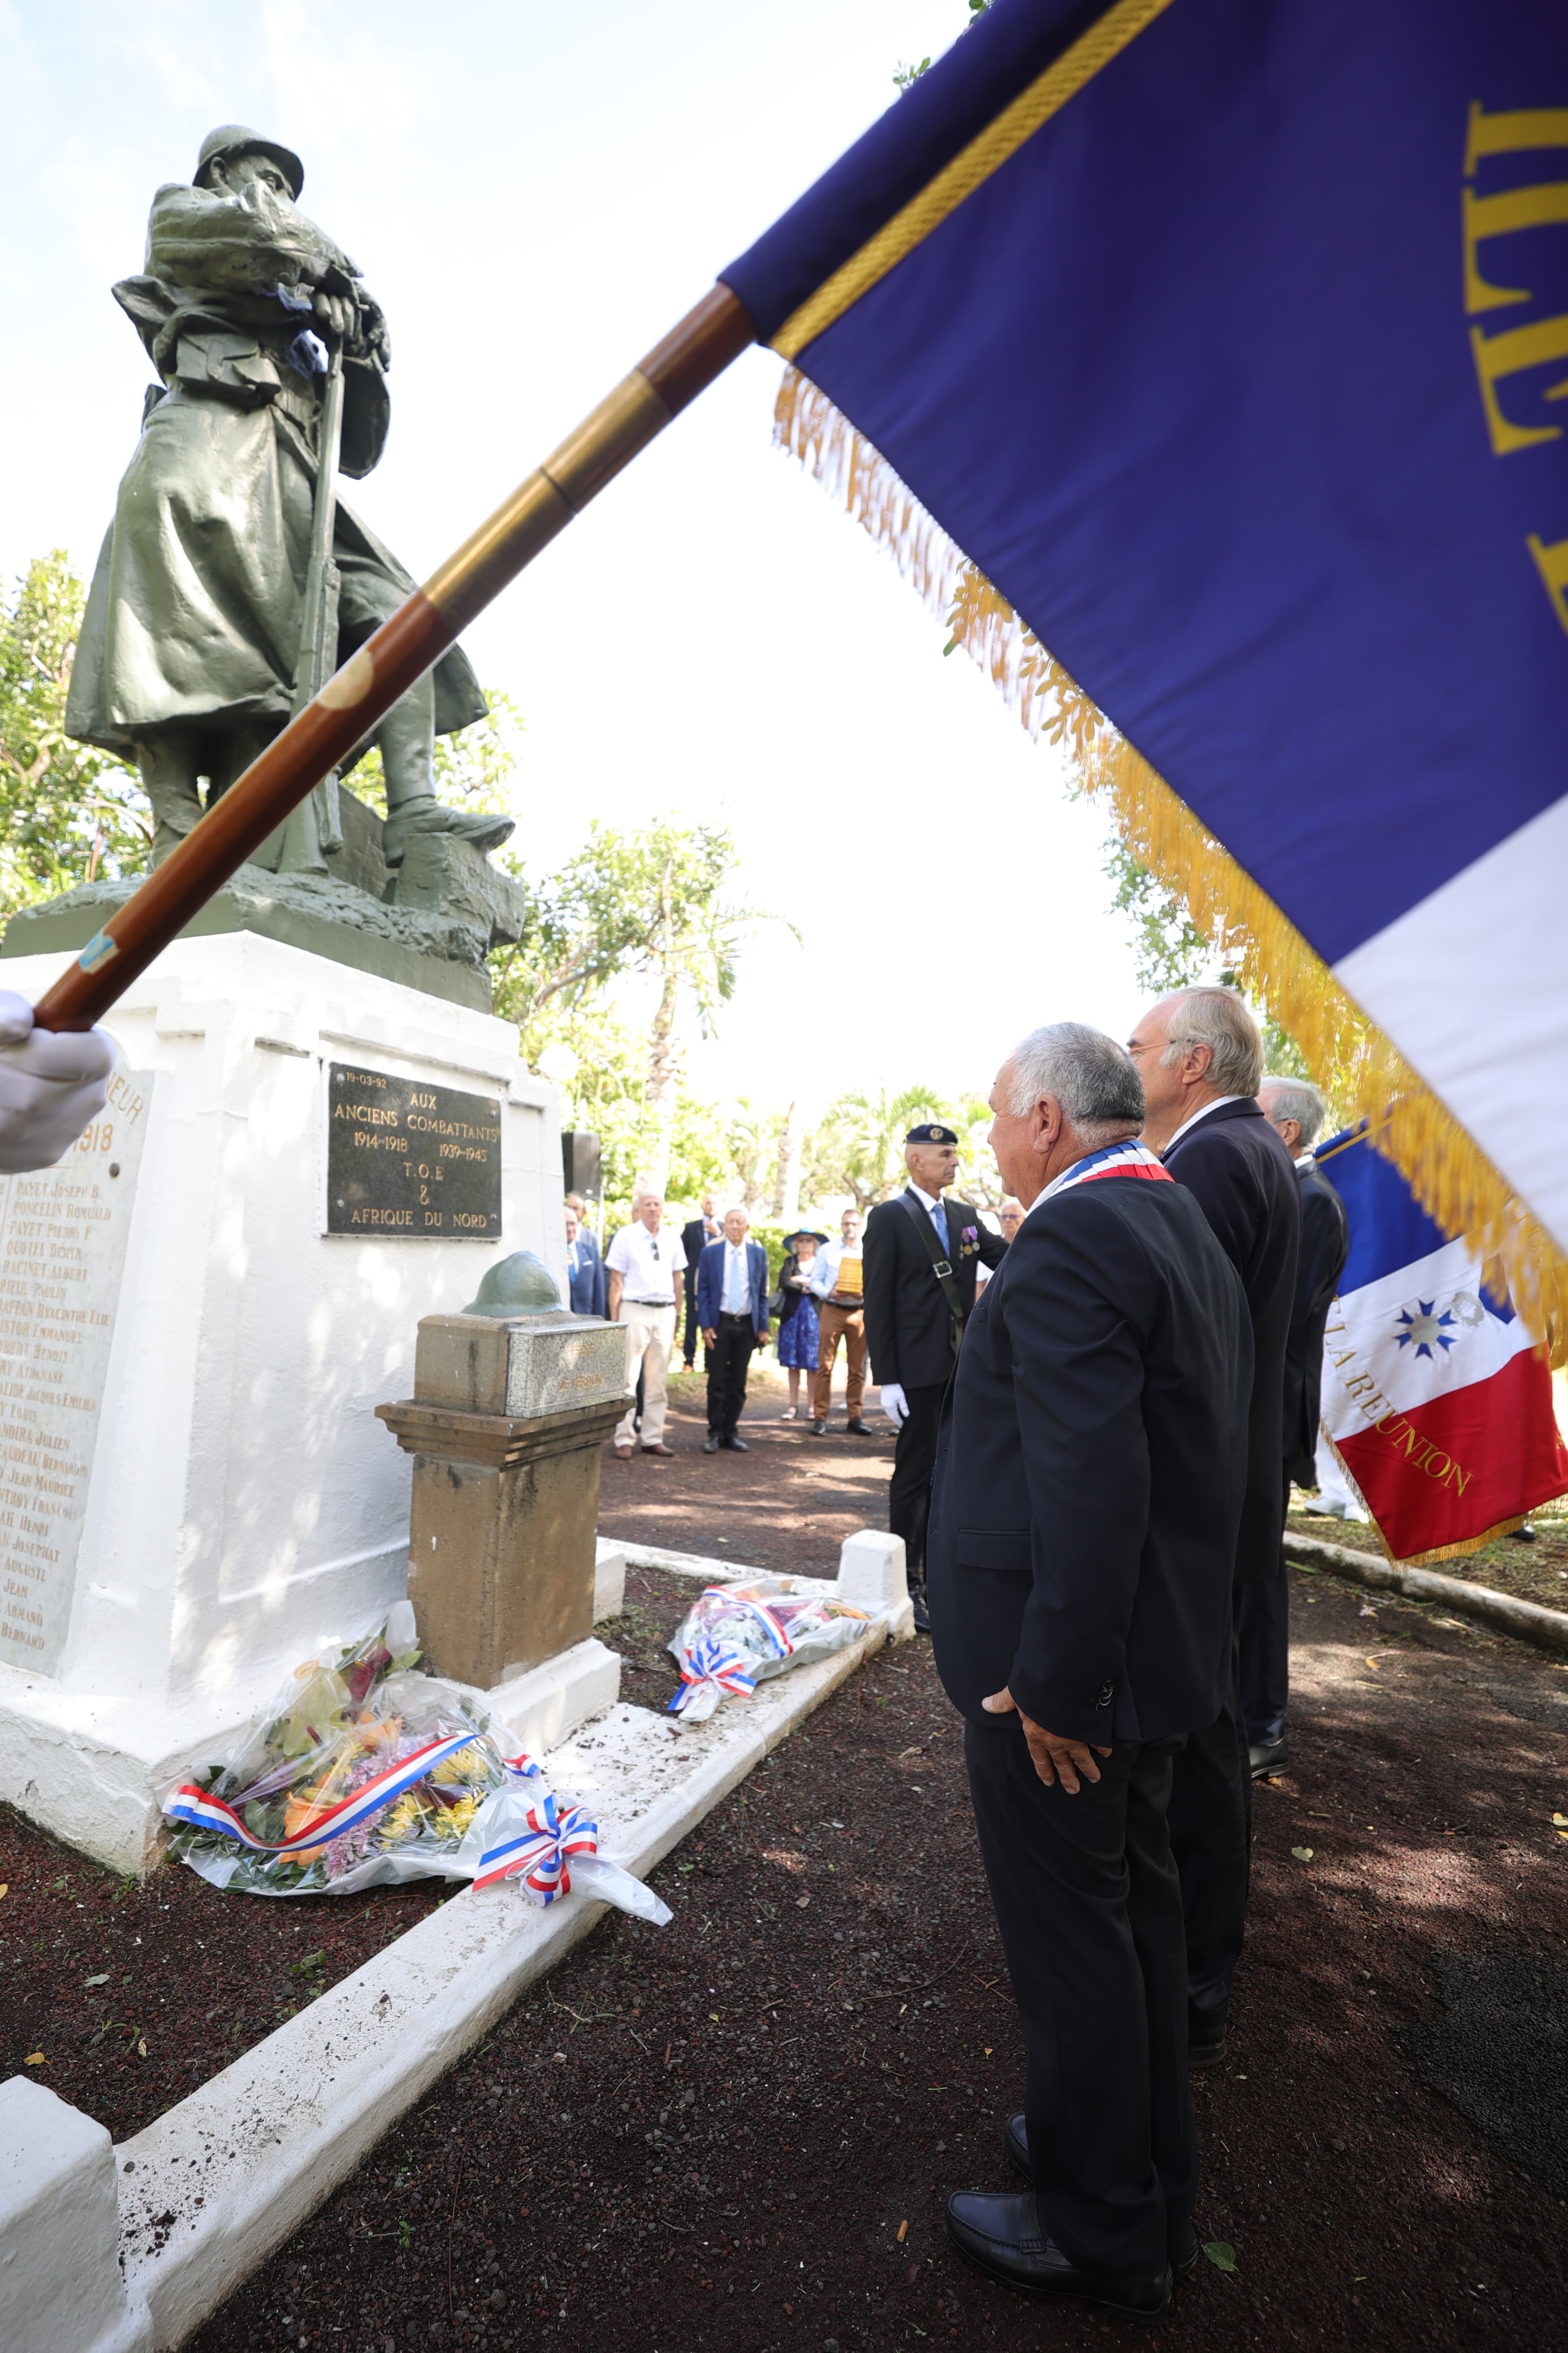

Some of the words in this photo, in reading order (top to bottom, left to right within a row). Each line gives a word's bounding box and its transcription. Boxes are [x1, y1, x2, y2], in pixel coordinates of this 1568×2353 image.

[345, 1071, 387, 1089] 19-03-92
[409, 1093, 437, 1110] AUX
[334, 1104, 399, 1127] ANCIENS
[407, 1114, 498, 1143] COMBATTANTS
[354, 1131, 408, 1153] 1914-1918
[439, 1143, 487, 1162] 1939-1945
[420, 1184, 430, 1205] &
[351, 1208, 413, 1226] AFRIQUE
[425, 1211, 442, 1227] DU
[453, 1213, 487, 1229] NORD
